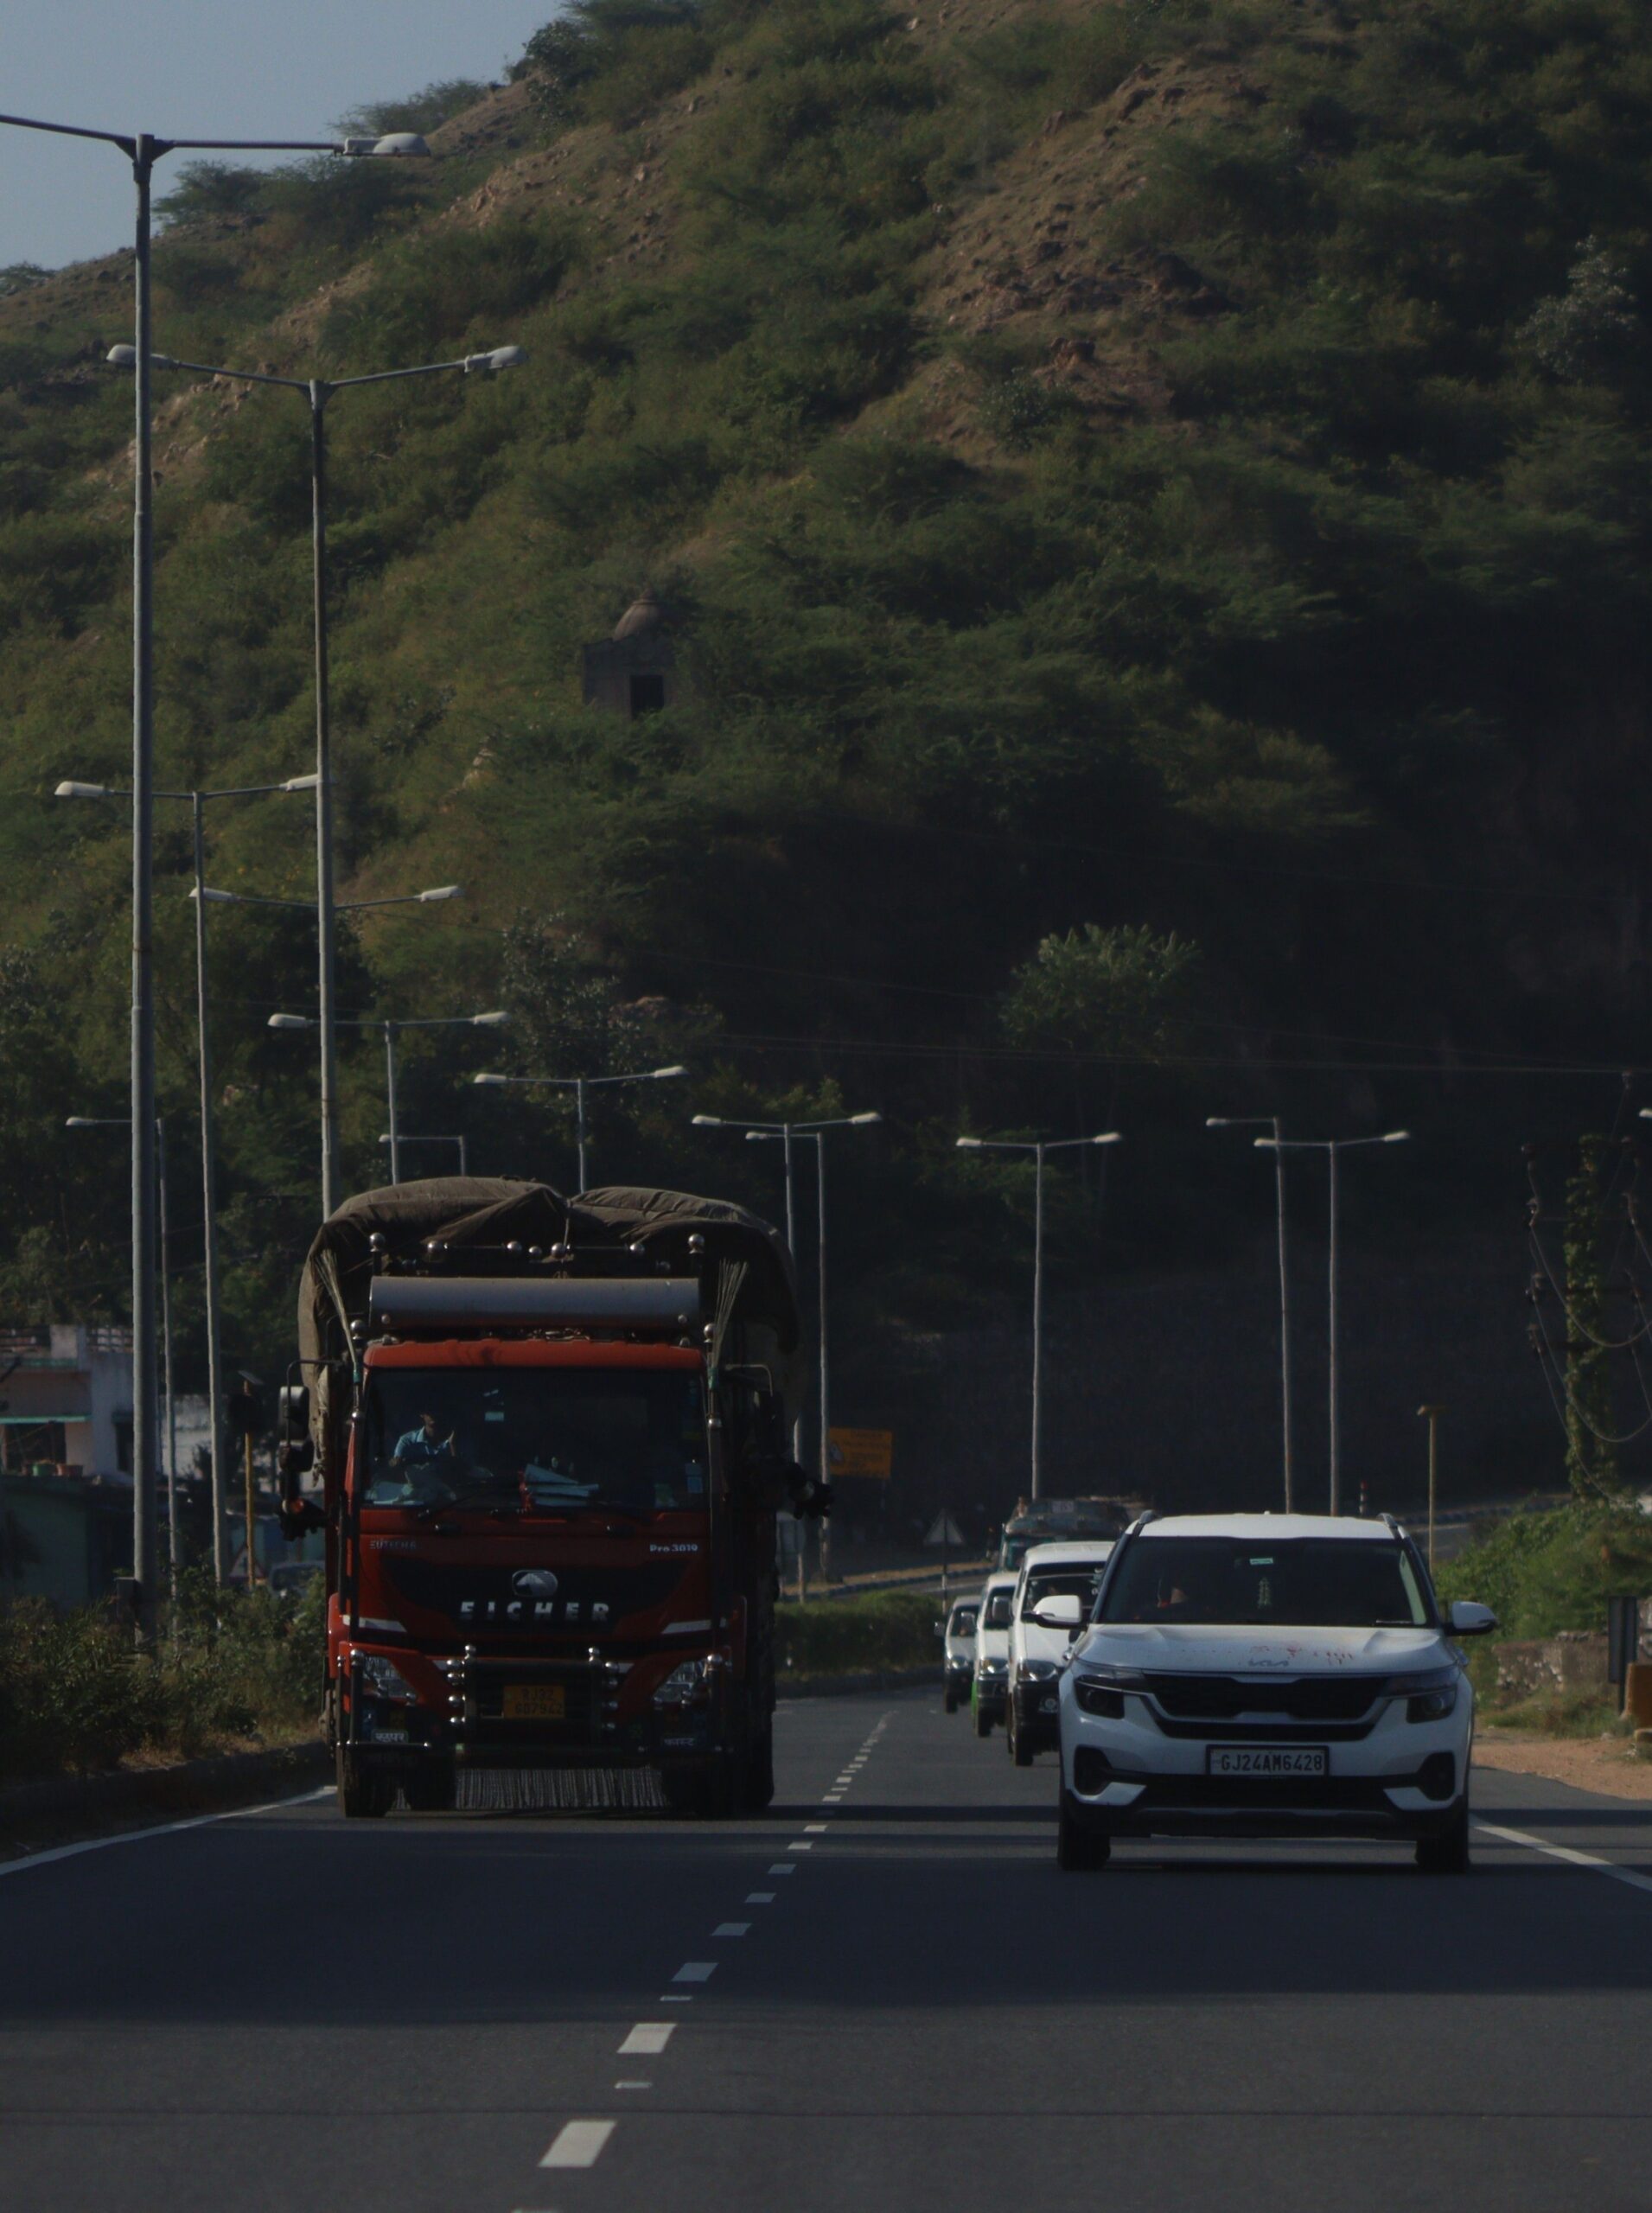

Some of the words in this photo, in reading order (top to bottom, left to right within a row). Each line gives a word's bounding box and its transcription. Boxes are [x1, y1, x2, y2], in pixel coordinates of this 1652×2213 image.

[649, 1544, 670, 1553] Pro
[671, 1544, 698, 1553] 3019
[460, 1601, 609, 1621] EICHER
[1221, 1754, 1323, 1771] GJ24AM6428
